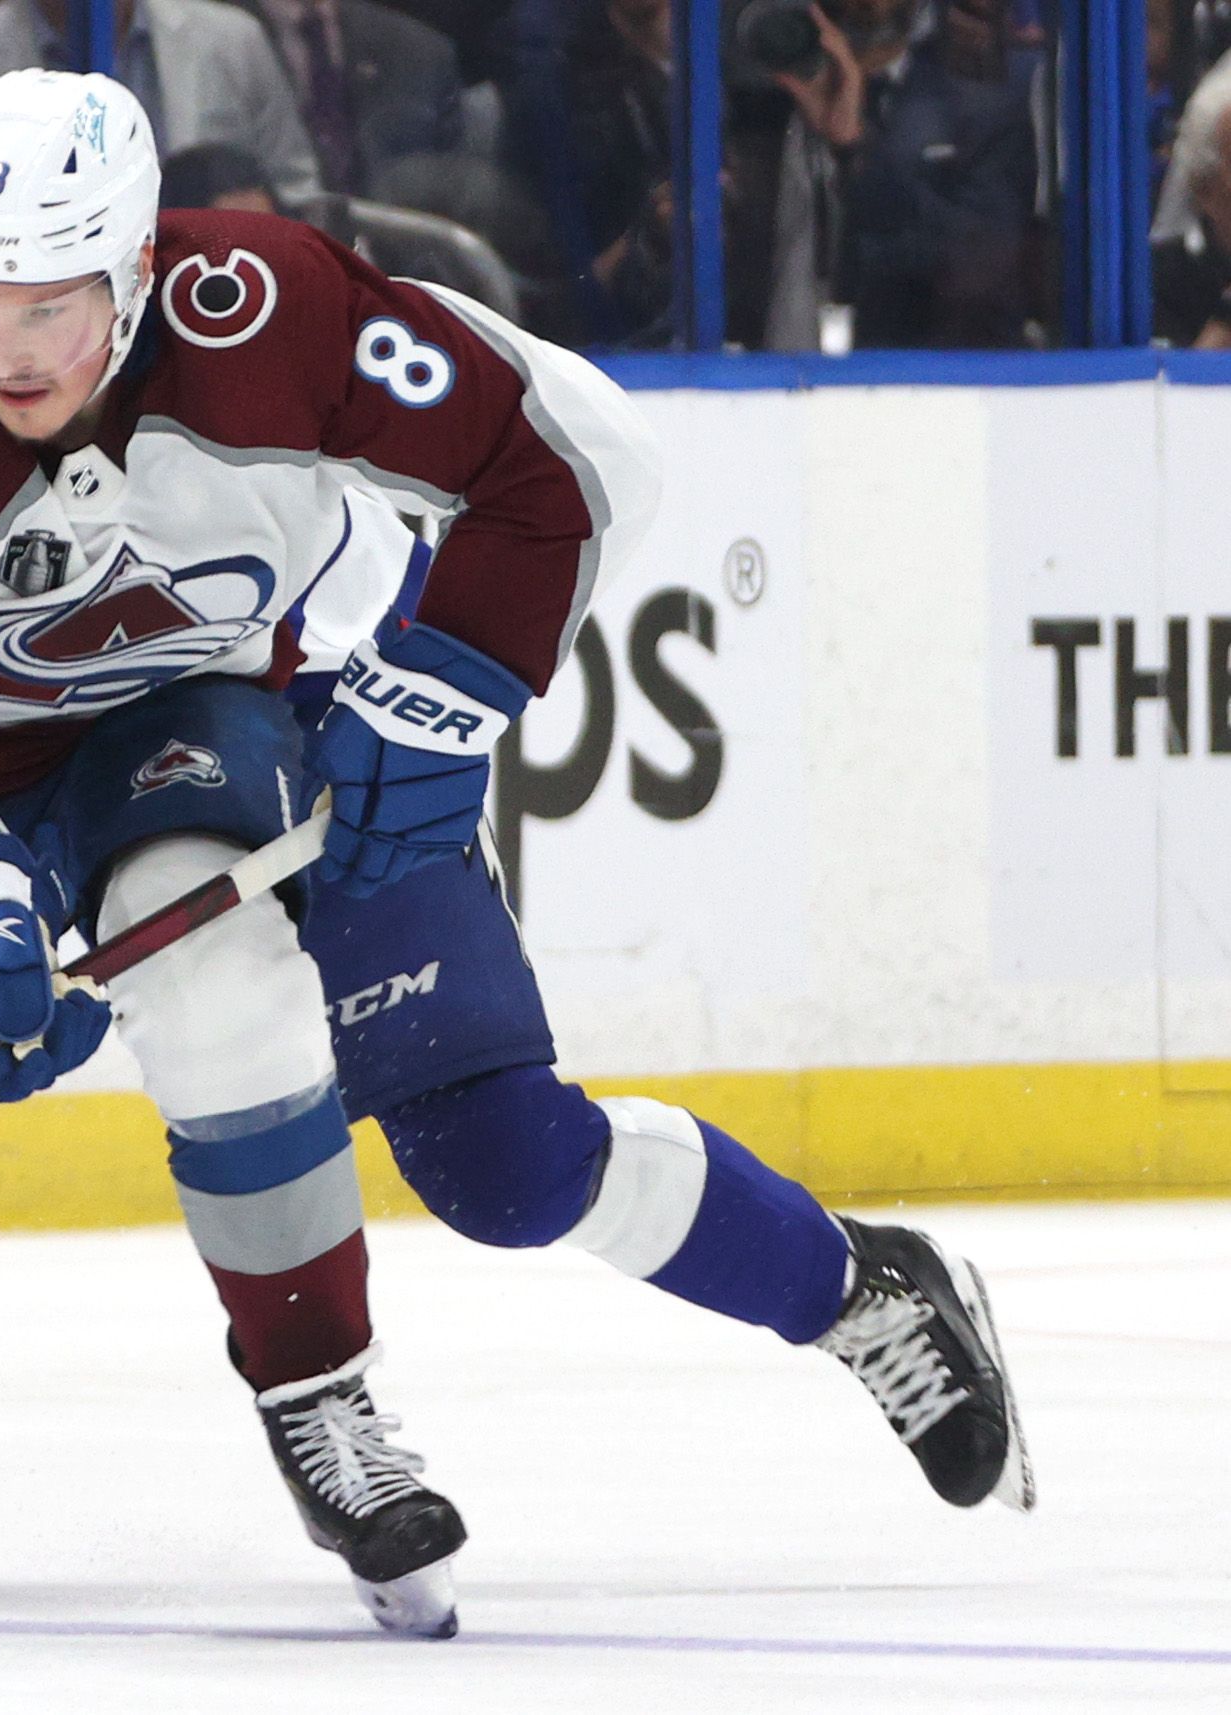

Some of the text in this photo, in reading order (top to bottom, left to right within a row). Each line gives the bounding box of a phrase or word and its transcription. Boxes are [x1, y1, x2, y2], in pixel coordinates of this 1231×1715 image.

[354, 315, 457, 410] 8
[339, 651, 484, 744] AUER
[325, 960, 440, 1027] CM
